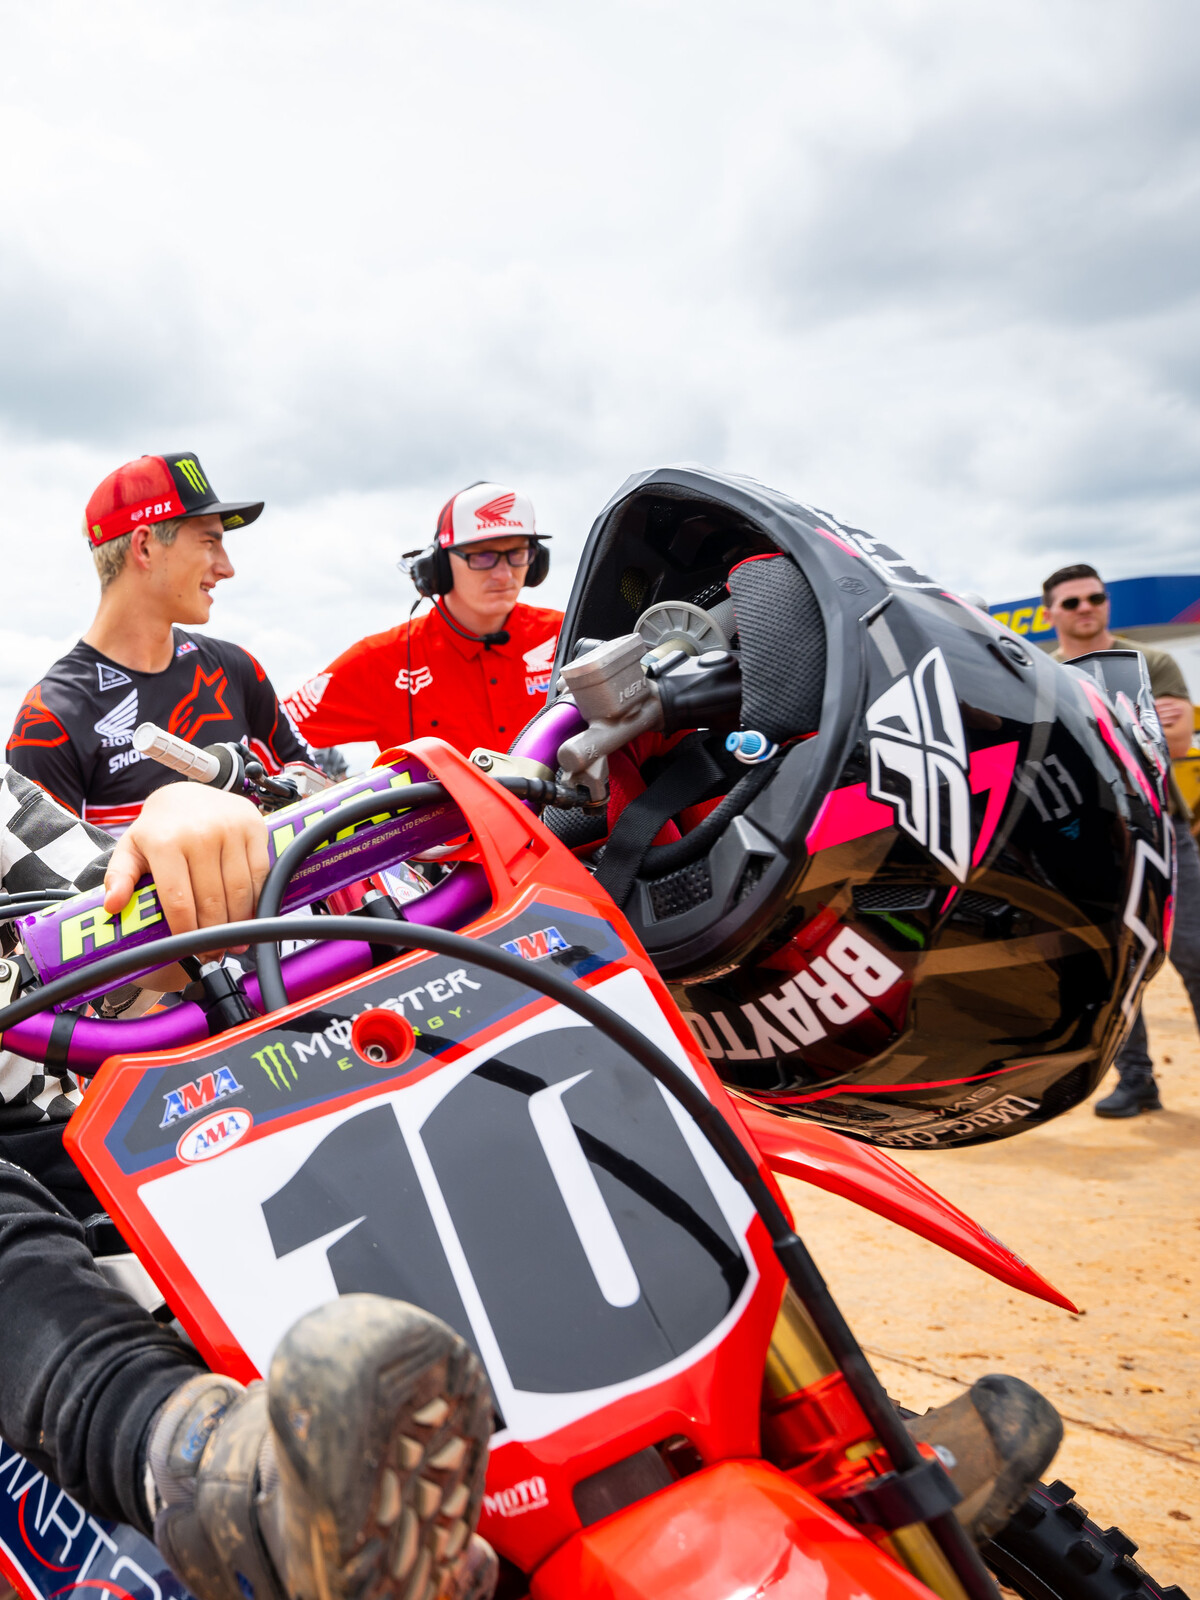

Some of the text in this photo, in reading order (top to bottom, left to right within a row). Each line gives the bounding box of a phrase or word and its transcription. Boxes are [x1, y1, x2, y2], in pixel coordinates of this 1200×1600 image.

[145, 501, 172, 518] FOX
[476, 520, 524, 530] HONDA
[322, 845, 362, 869] TRADEMARK
[361, 841, 371, 851] OF
[371, 828, 402, 846] RENTHAL
[402, 821, 414, 832] LTD
[414, 807, 445, 827] ENGLAND
[291, 968, 482, 1064] MOSTER
[159, 1065, 244, 1129] AMA
[194, 1115, 241, 1155] AMA
[261, 1026, 751, 1430] 10
[483, 1475, 547, 1517] MOTO
